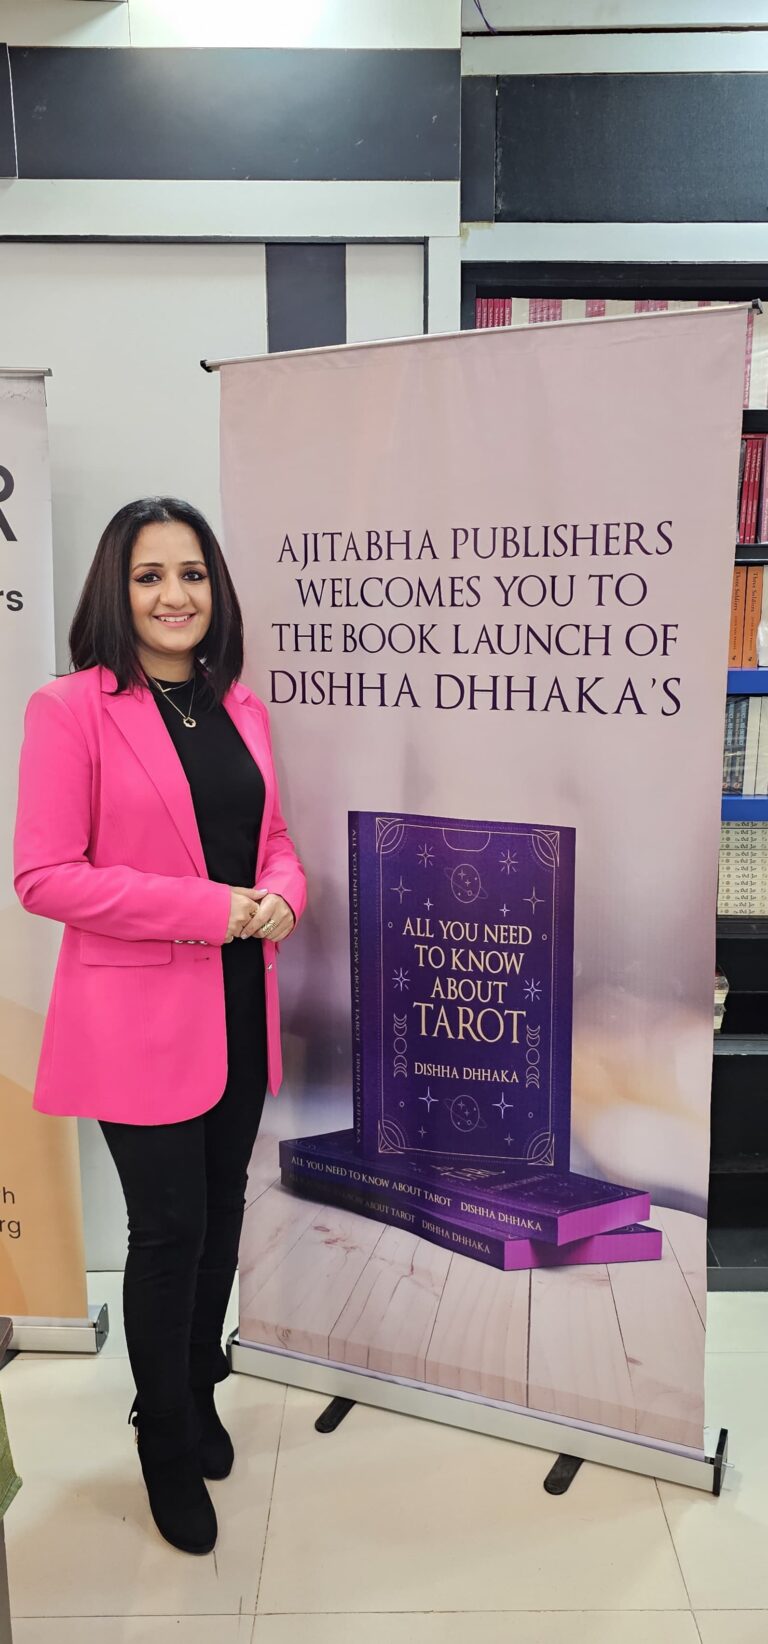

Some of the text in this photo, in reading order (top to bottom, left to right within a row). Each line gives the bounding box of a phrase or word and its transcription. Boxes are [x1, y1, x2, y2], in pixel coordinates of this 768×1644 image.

[277, 520, 673, 571] AJITABHA PUBLISHERS
[295, 572, 649, 609] WELCOMES YOU TO
[271, 622, 679, 657] THE BOOK LAUNCH OF
[268, 669, 682, 717] DISHHA DHHAKA'S
[403, 917, 532, 945] ALL YOU NEED
[414, 944, 525, 975] TO KNOW
[430, 976, 508, 1004] ABOUT
[413, 1002, 527, 1044] TAROT
[414, 1062, 519, 1083] DISHHA DHHAKA
[291, 1155, 542, 1232] ALL YOU NEED TO KNOW ABOUT TAROT DISHHA DHHAKA
[365, 1199, 390, 1214] ABOUT
[390, 1206, 416, 1223] TAROT
[421, 1219, 450, 1239] DISHHA
[451, 1232, 491, 1254] DHHAKA
